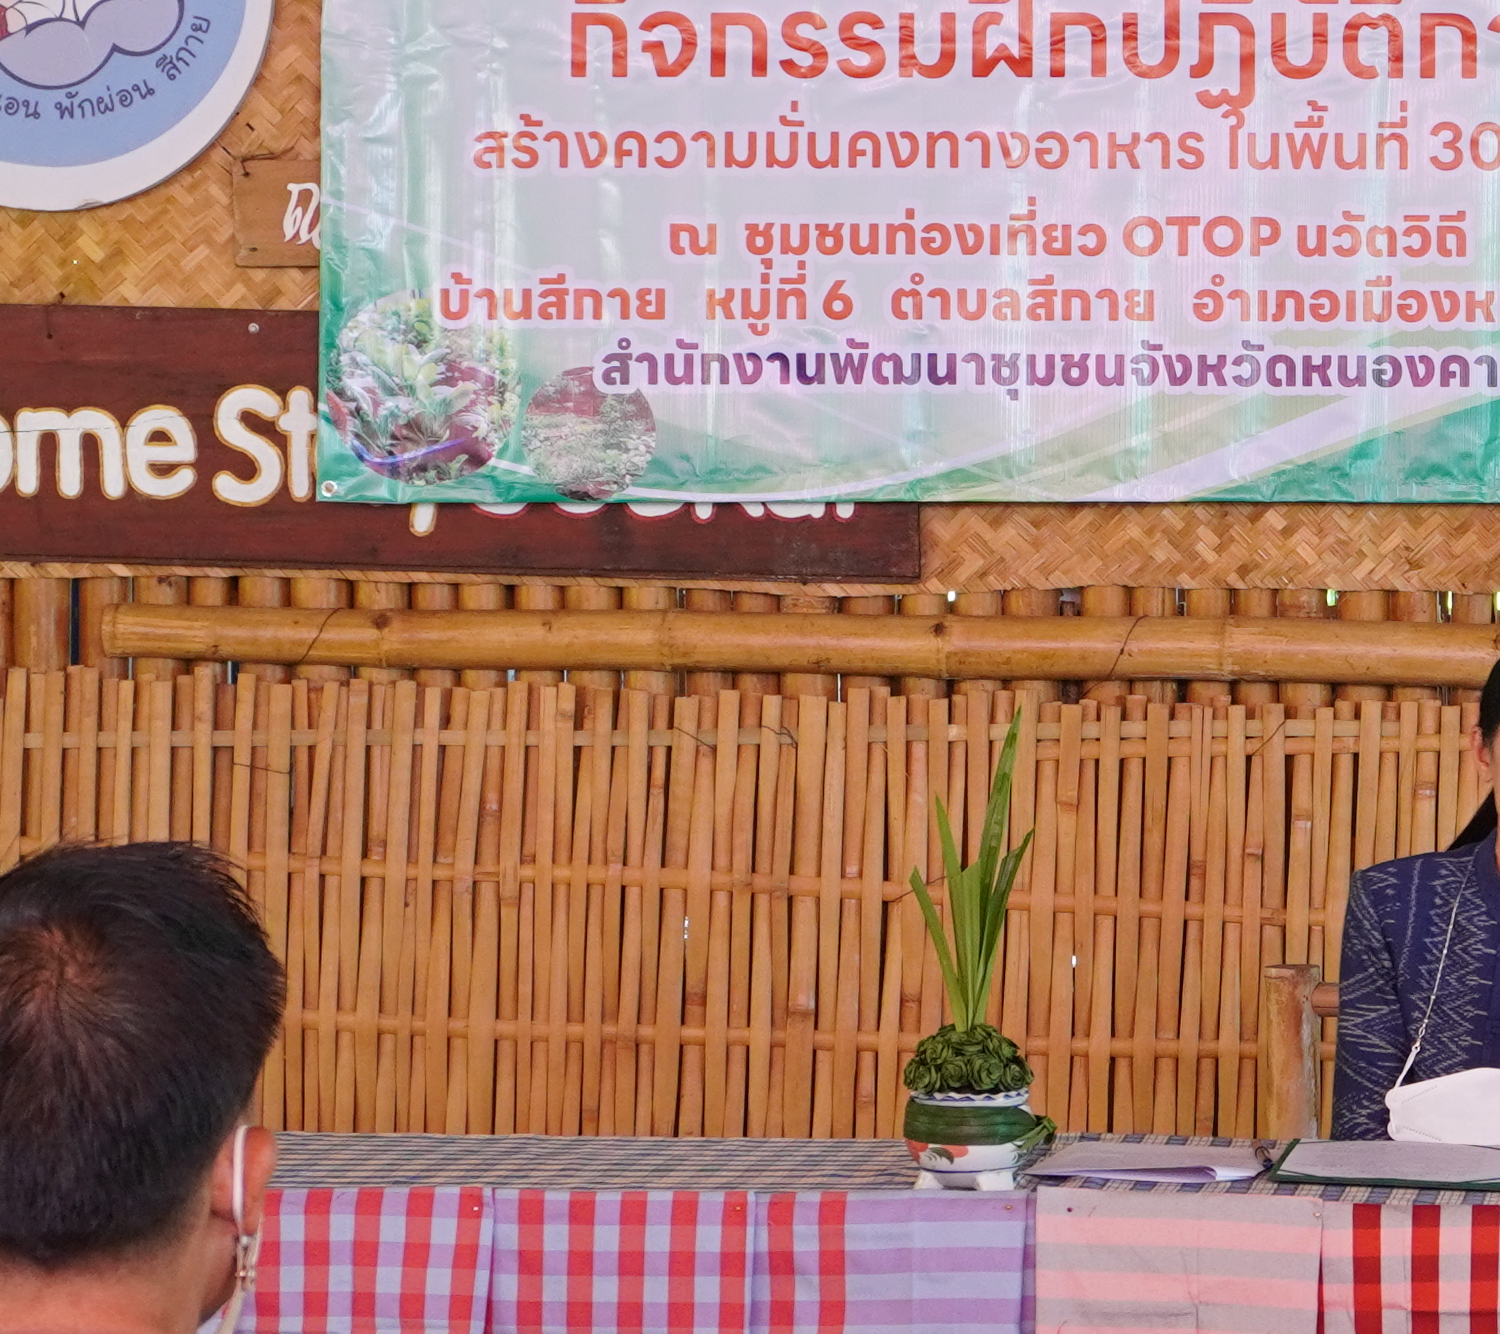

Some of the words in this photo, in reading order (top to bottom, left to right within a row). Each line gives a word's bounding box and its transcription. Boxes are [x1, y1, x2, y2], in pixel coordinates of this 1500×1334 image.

[55, 79, 155, 120] พักผ่อน
[155, 15, 211, 81] สีกาย
[473, 102, 1204, 170] สร้างความมั่นคงทางอาหาร
[1221, 100, 1410, 172] ในพื้นที่
[669, 222, 717, 257] ณ
[744, 196, 1107, 268] ชุมชนท่องเที่ยว
[1122, 216, 1281, 258] OTOP
[1297, 210, 1468, 258] นวัตวิถี
[440, 272, 666, 322] บ้านสีกาย
[705, 260, 808, 337] หมู่ที่
[823, 279, 854, 322] 6
[891, 274, 1155, 322] ตำบลสีกาย
